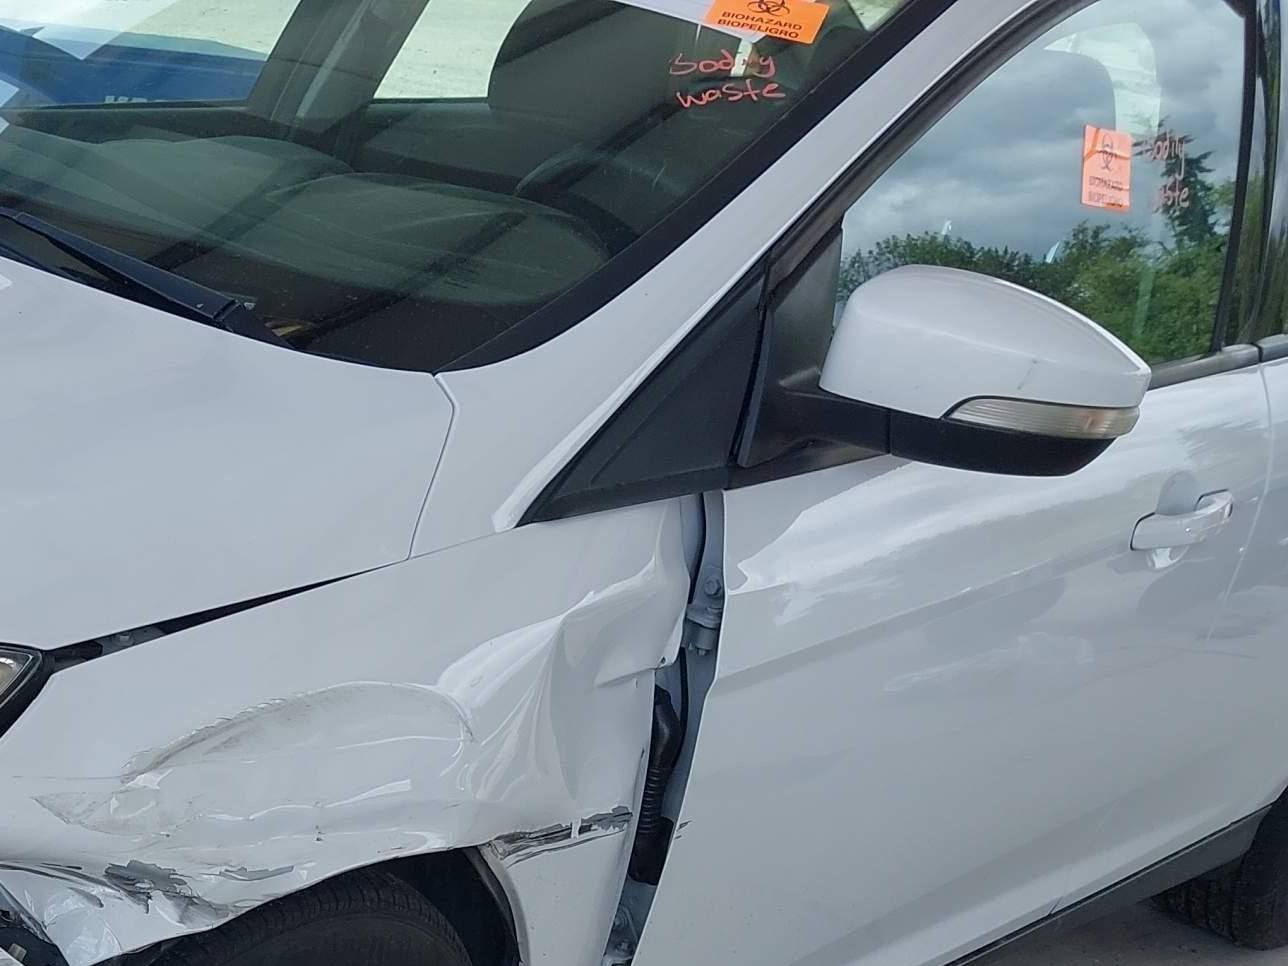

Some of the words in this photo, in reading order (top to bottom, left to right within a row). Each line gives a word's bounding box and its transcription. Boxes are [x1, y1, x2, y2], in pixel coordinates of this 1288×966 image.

[717, 18, 800, 39] BIOPELIGRO
[721, 10, 803, 32] BIOHAZARD
[676, 78, 786, 108] waste
